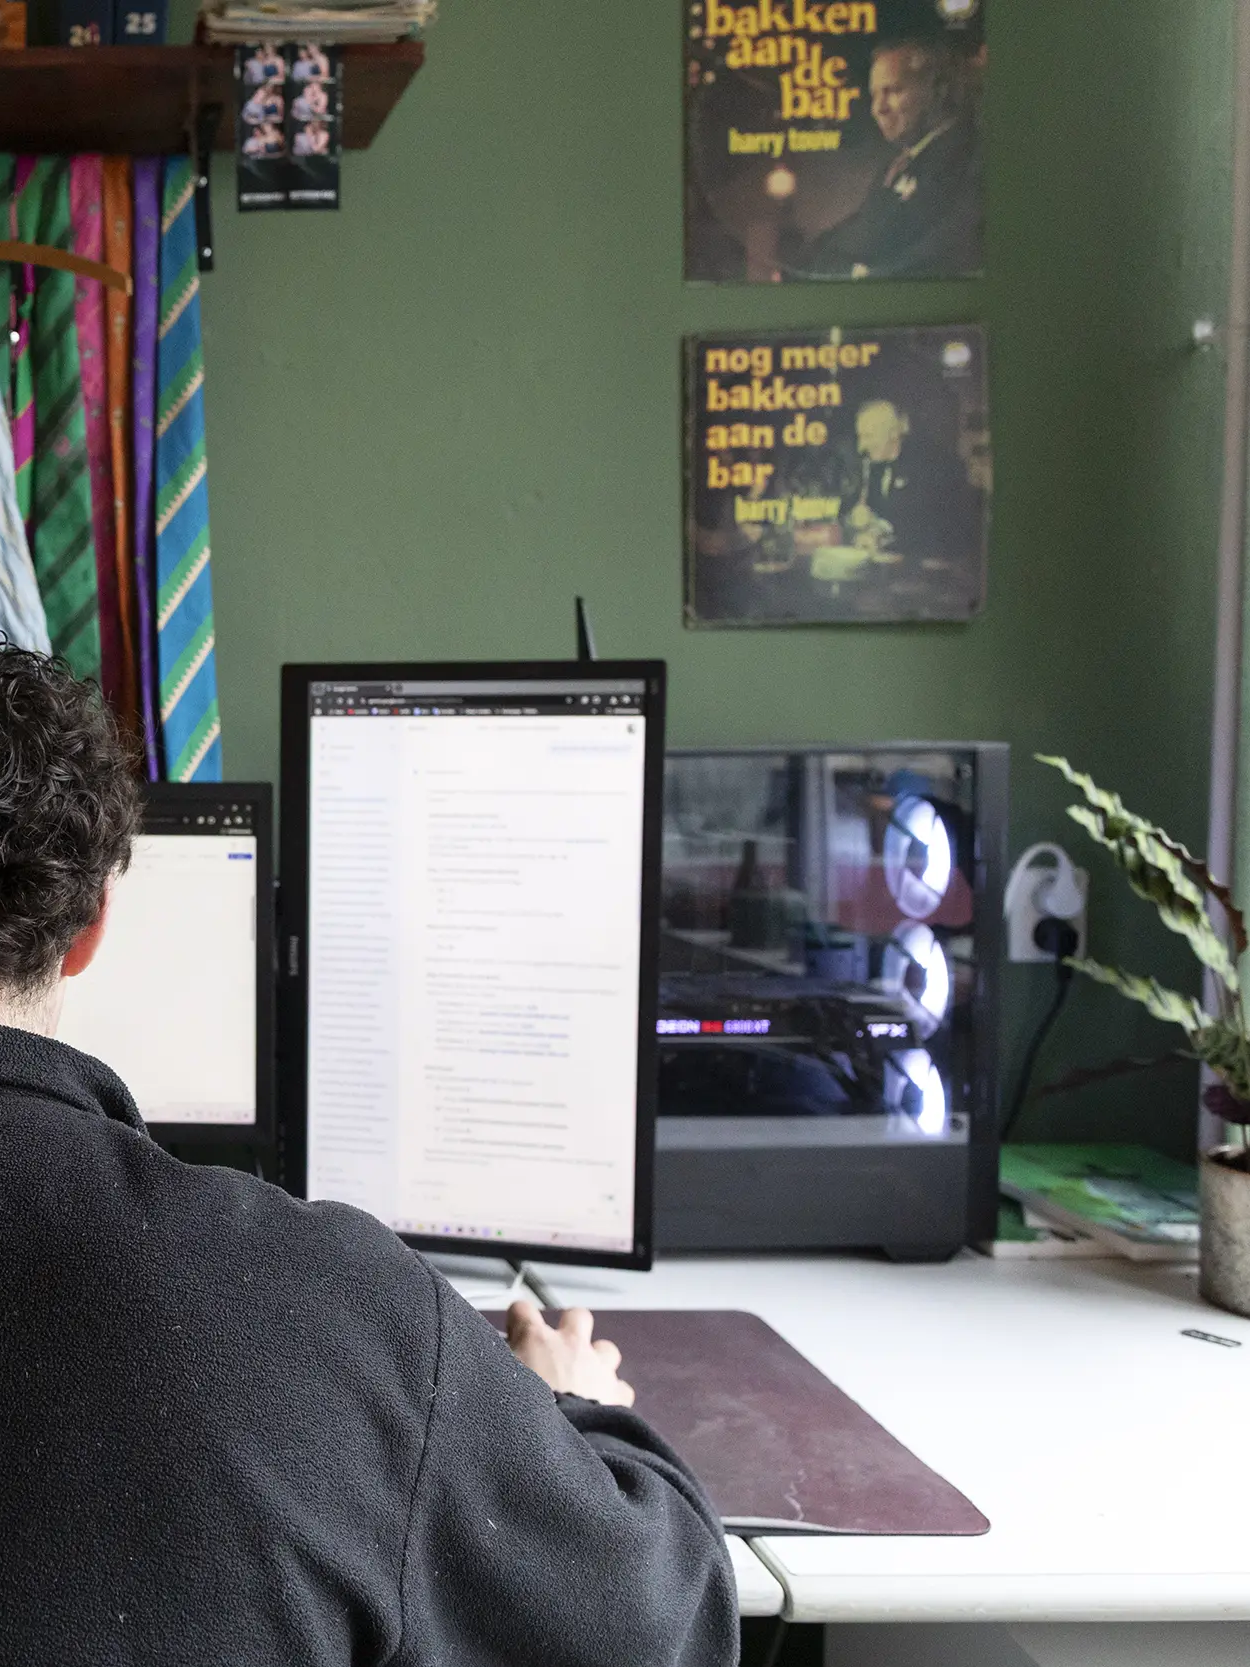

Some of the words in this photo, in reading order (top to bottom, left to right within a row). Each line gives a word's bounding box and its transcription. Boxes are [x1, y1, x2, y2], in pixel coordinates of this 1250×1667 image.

[125, 12, 157, 35] 25
[706, 0, 877, 37] bakken
[725, 34, 807, 69] aan
[793, 42, 848, 88] de
[780, 71, 860, 121] bar
[705, 347, 773, 377] nog
[781, 342, 880, 370] meer
[705, 376, 842, 412] bakken
[705, 421, 775, 450] aan
[782, 413, 828, 447] de
[706, 456, 774, 489] bar
